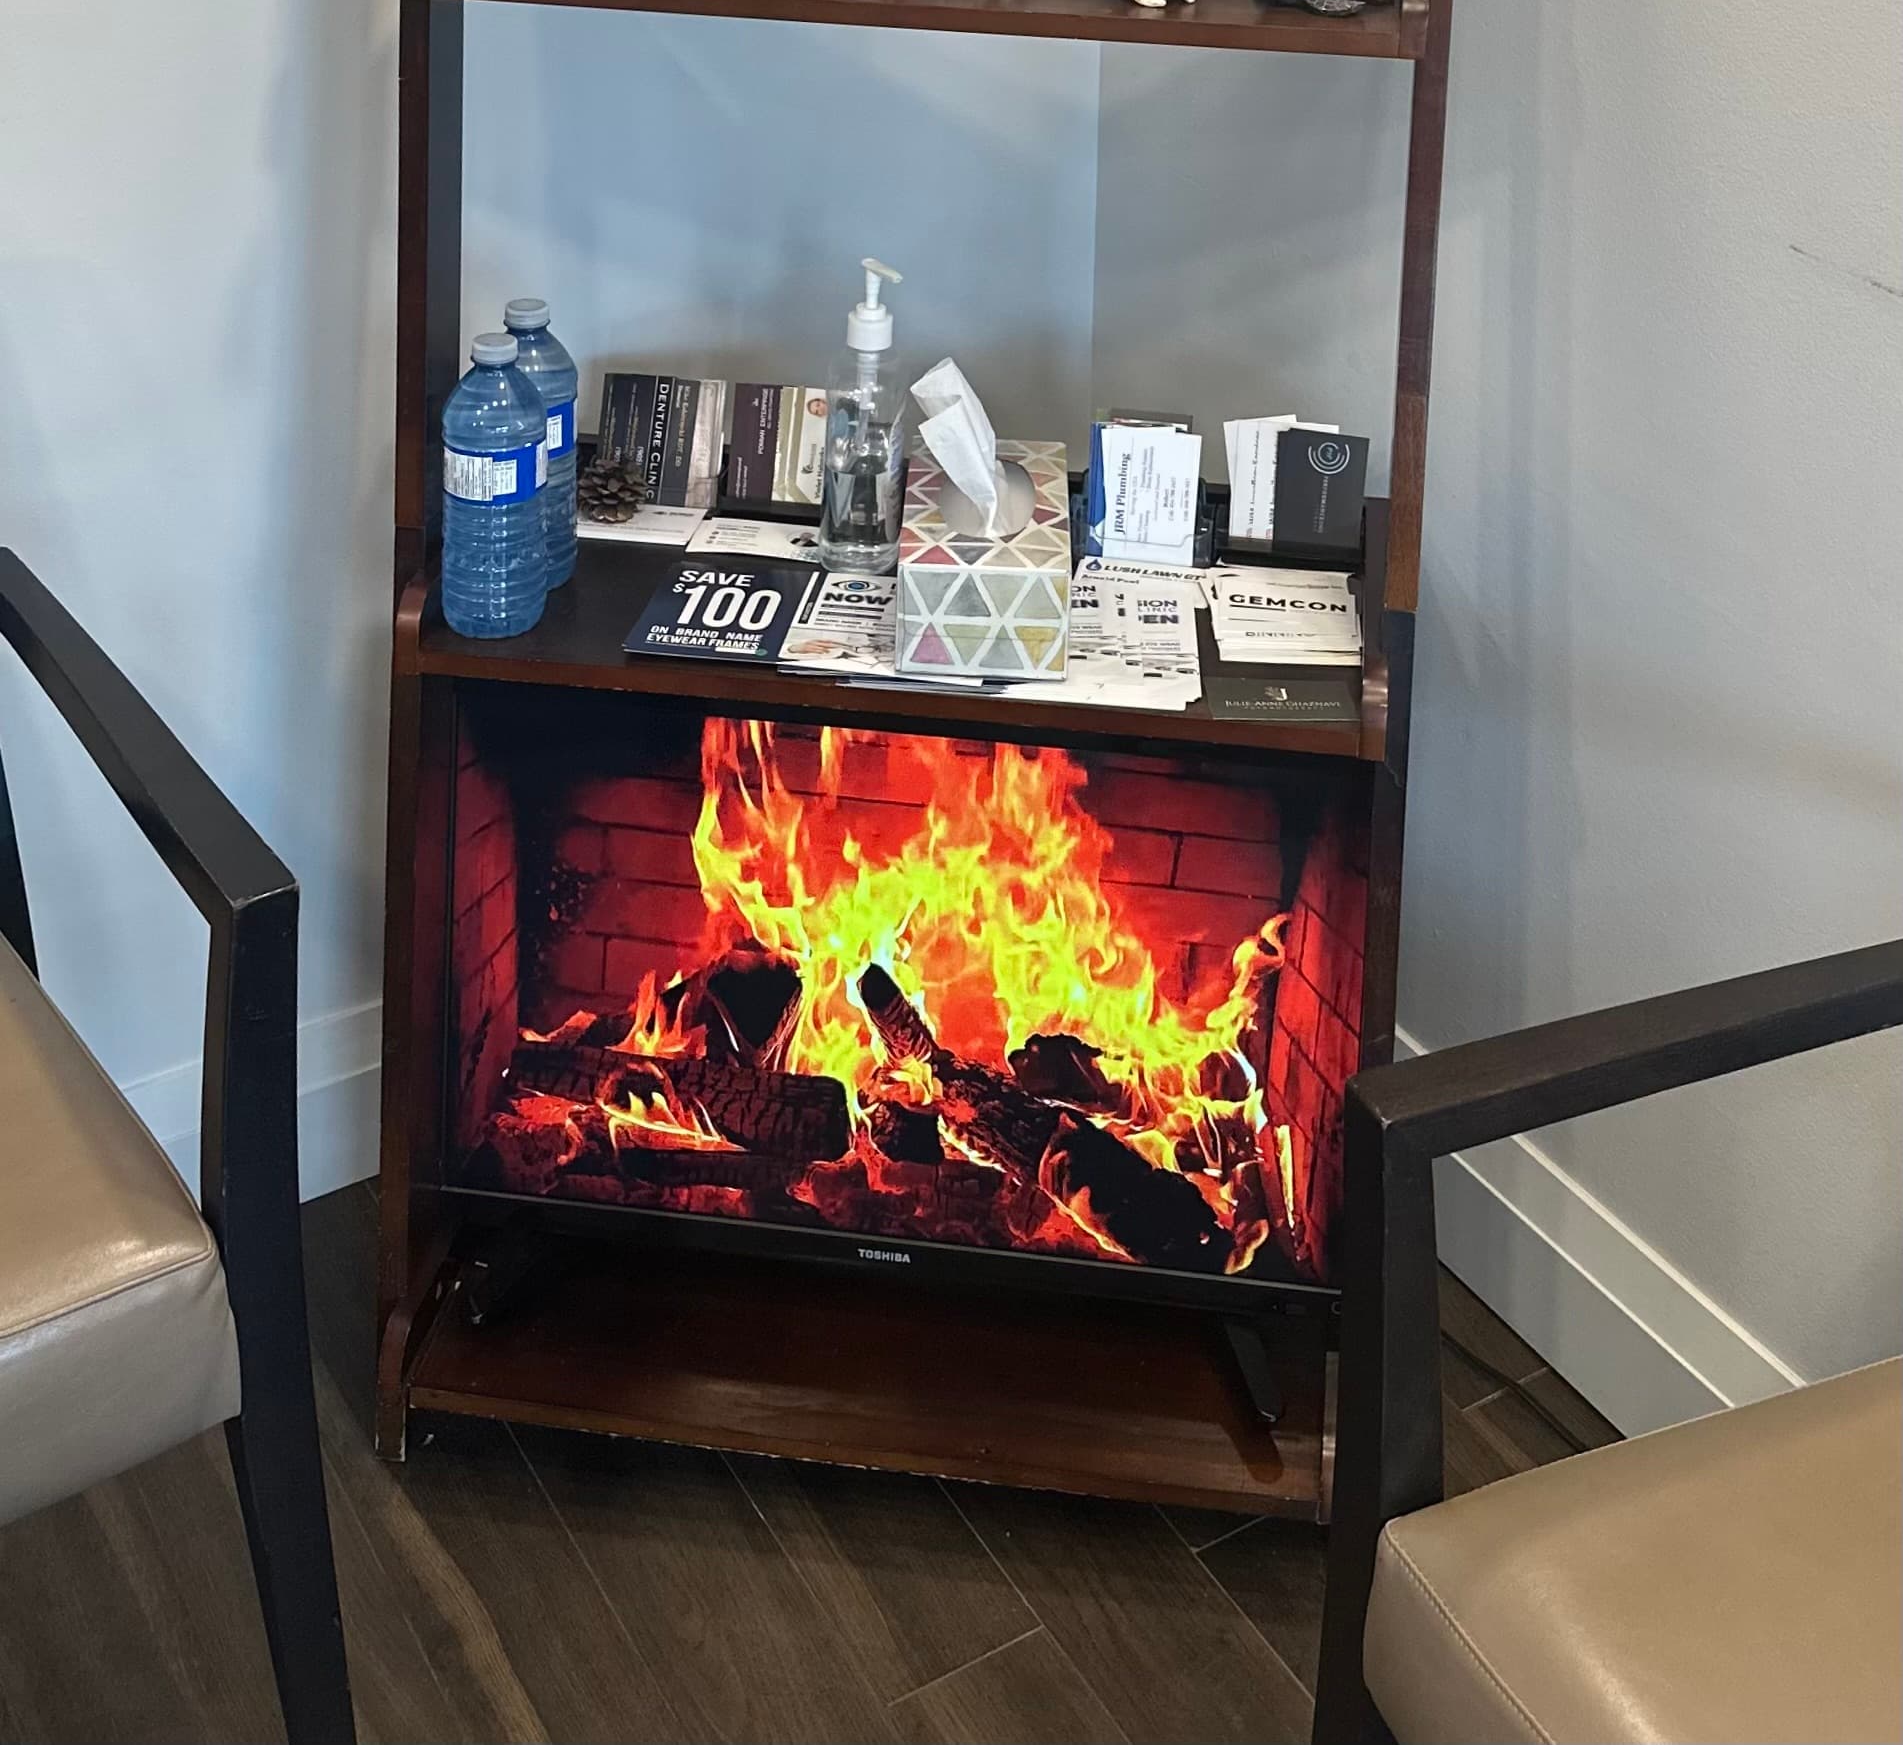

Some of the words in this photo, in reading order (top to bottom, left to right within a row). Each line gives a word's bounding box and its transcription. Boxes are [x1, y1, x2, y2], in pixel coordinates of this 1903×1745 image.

[653, 383, 670, 448] DENTURE
[646, 452, 660, 499] CLINC
[1115, 453, 1131, 506] Plumbing
[1113, 509, 1126, 534] JRM
[1104, 565, 1140, 574] LUSH
[679, 570, 755, 587] SAVE
[672, 583, 782, 631] $100
[824, 592, 893, 605] NOW
[1229, 594, 1347, 612] GEMCON
[646, 633, 706, 646] EYEWEAR
[708, 638, 760, 650] FRAMES
[650, 625, 669, 634] ON
[675, 627, 719, 638] BRAND
[725, 632, 763, 642] NAME
[857, 1248, 911, 1263] TOSHIBA
